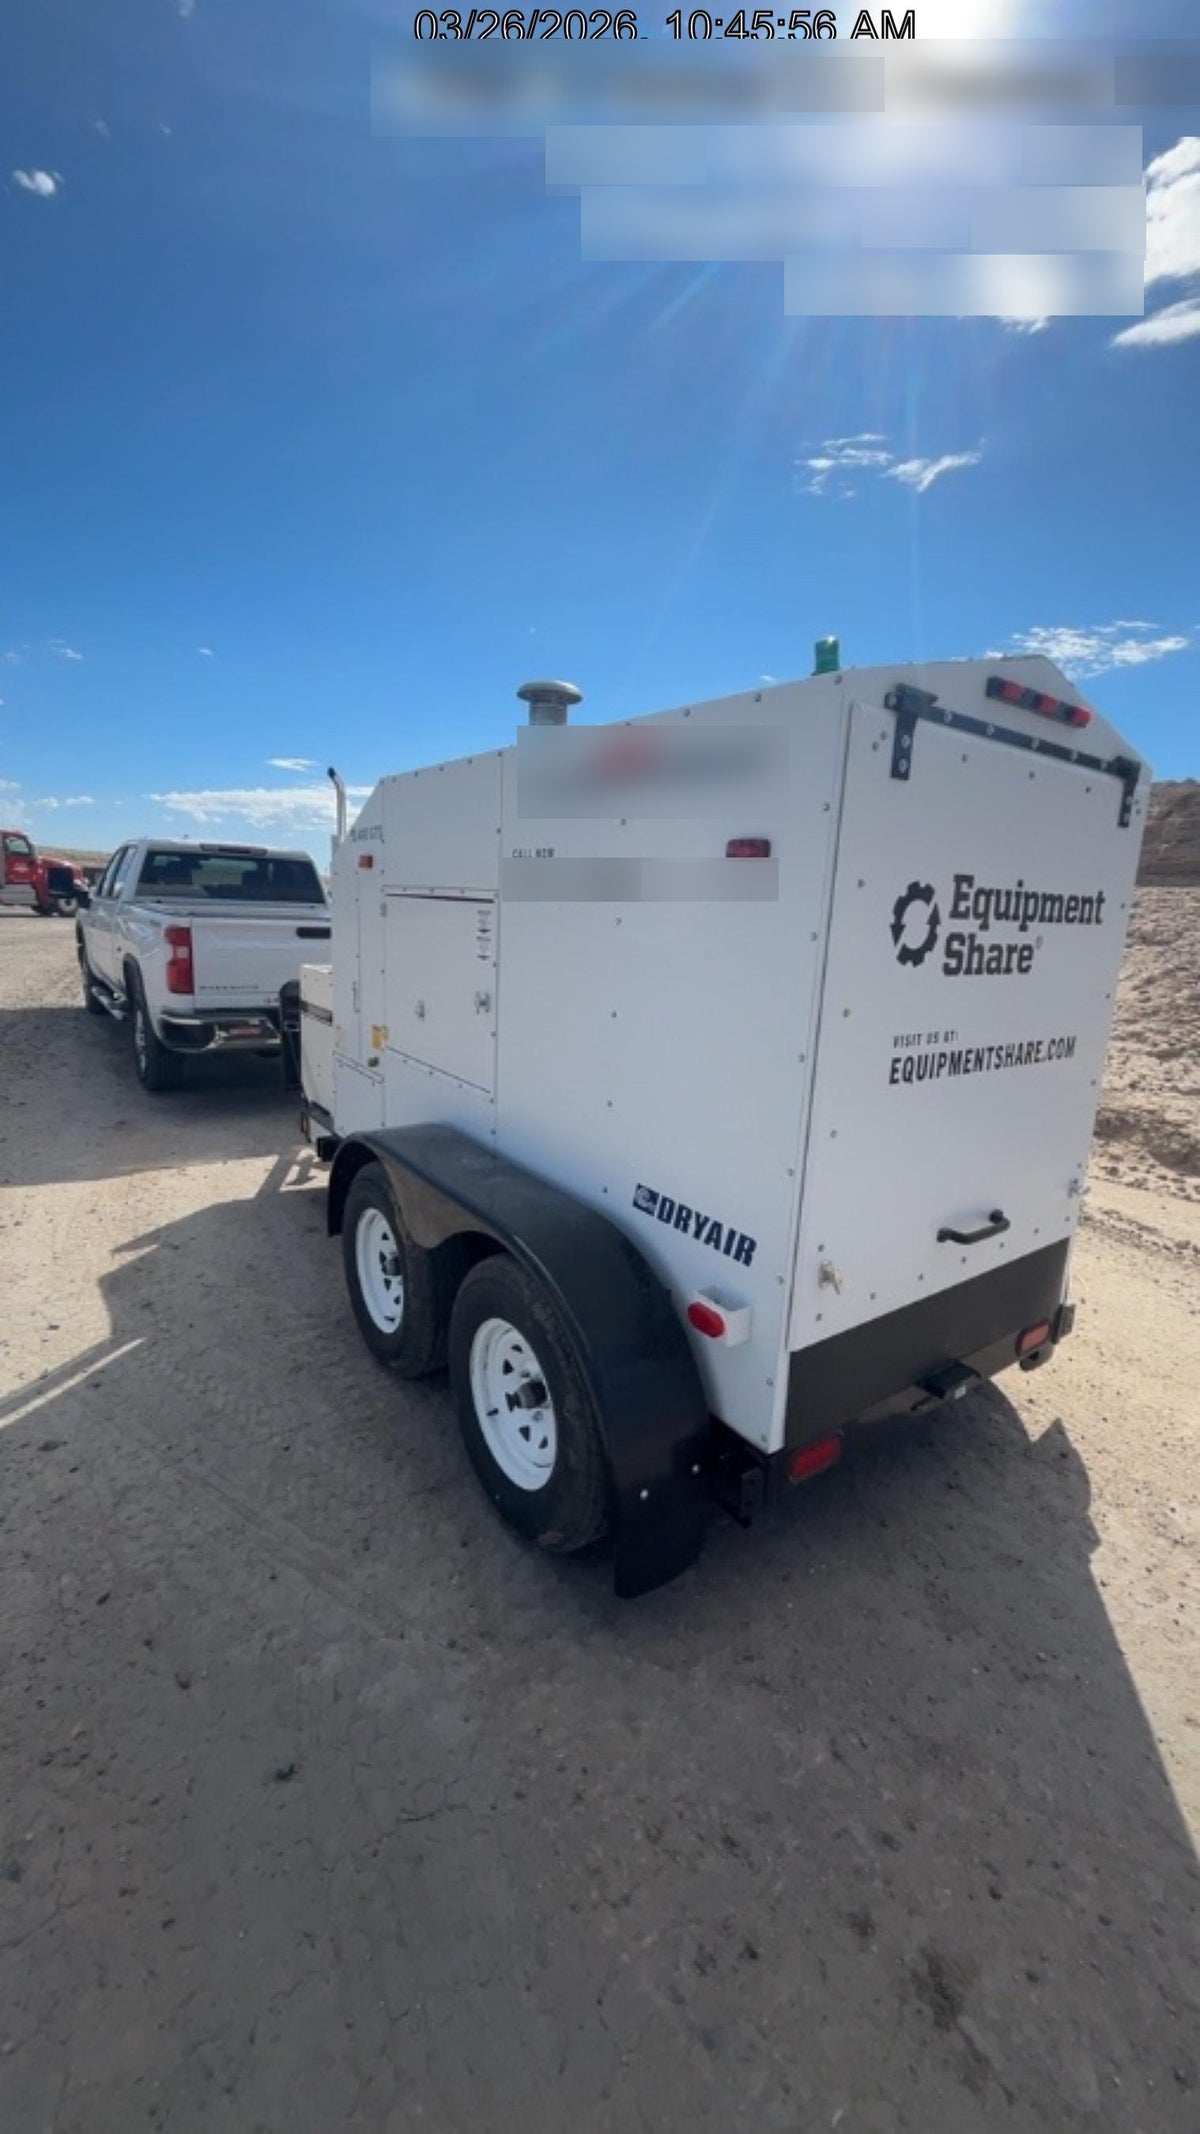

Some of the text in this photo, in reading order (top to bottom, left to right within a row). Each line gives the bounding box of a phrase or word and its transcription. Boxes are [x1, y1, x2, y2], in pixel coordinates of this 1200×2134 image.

[949, 874, 1106, 932] Equipment
[942, 932, 1034, 976] Share
[889, 1036, 1077, 1085] EQUIPMENTSHARE.COM
[893, 1033, 922, 1048] VISIT
[927, 1031, 940, 1045] US
[656, 1194, 757, 1267] DRYAIR
